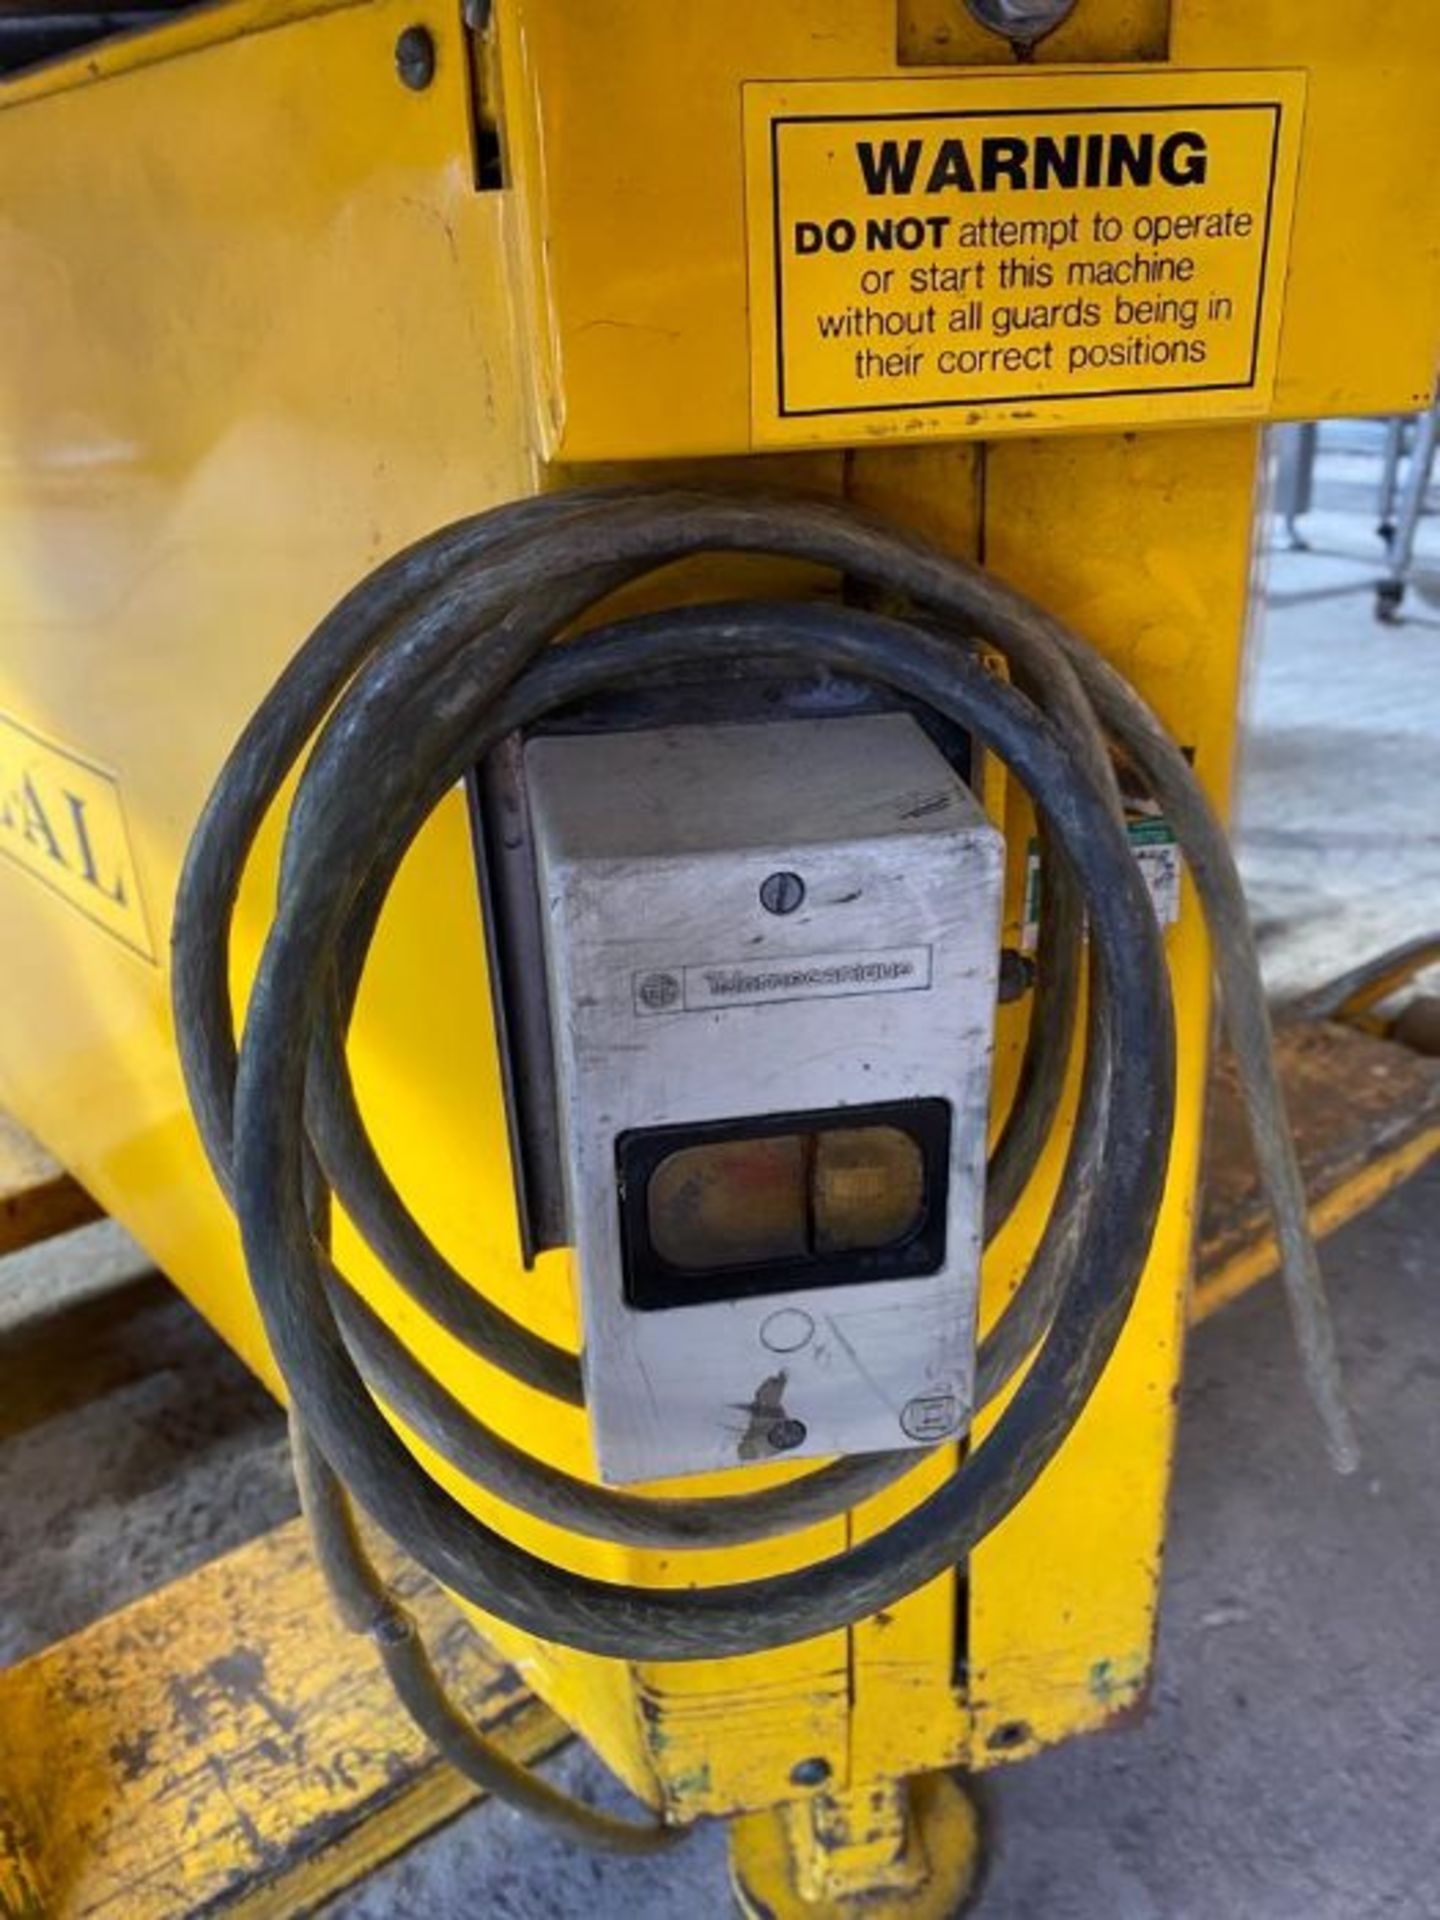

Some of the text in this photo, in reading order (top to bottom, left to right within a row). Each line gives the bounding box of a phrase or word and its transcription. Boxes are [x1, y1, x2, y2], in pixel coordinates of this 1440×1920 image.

[856, 131, 1207, 196] WARNING
[795, 208, 1253, 255] DO NOT attempt to operate
[861, 252, 1195, 295] or start this machine
[817, 291, 1233, 338] without all guards being in
[855, 338, 1207, 379] their correct positions
